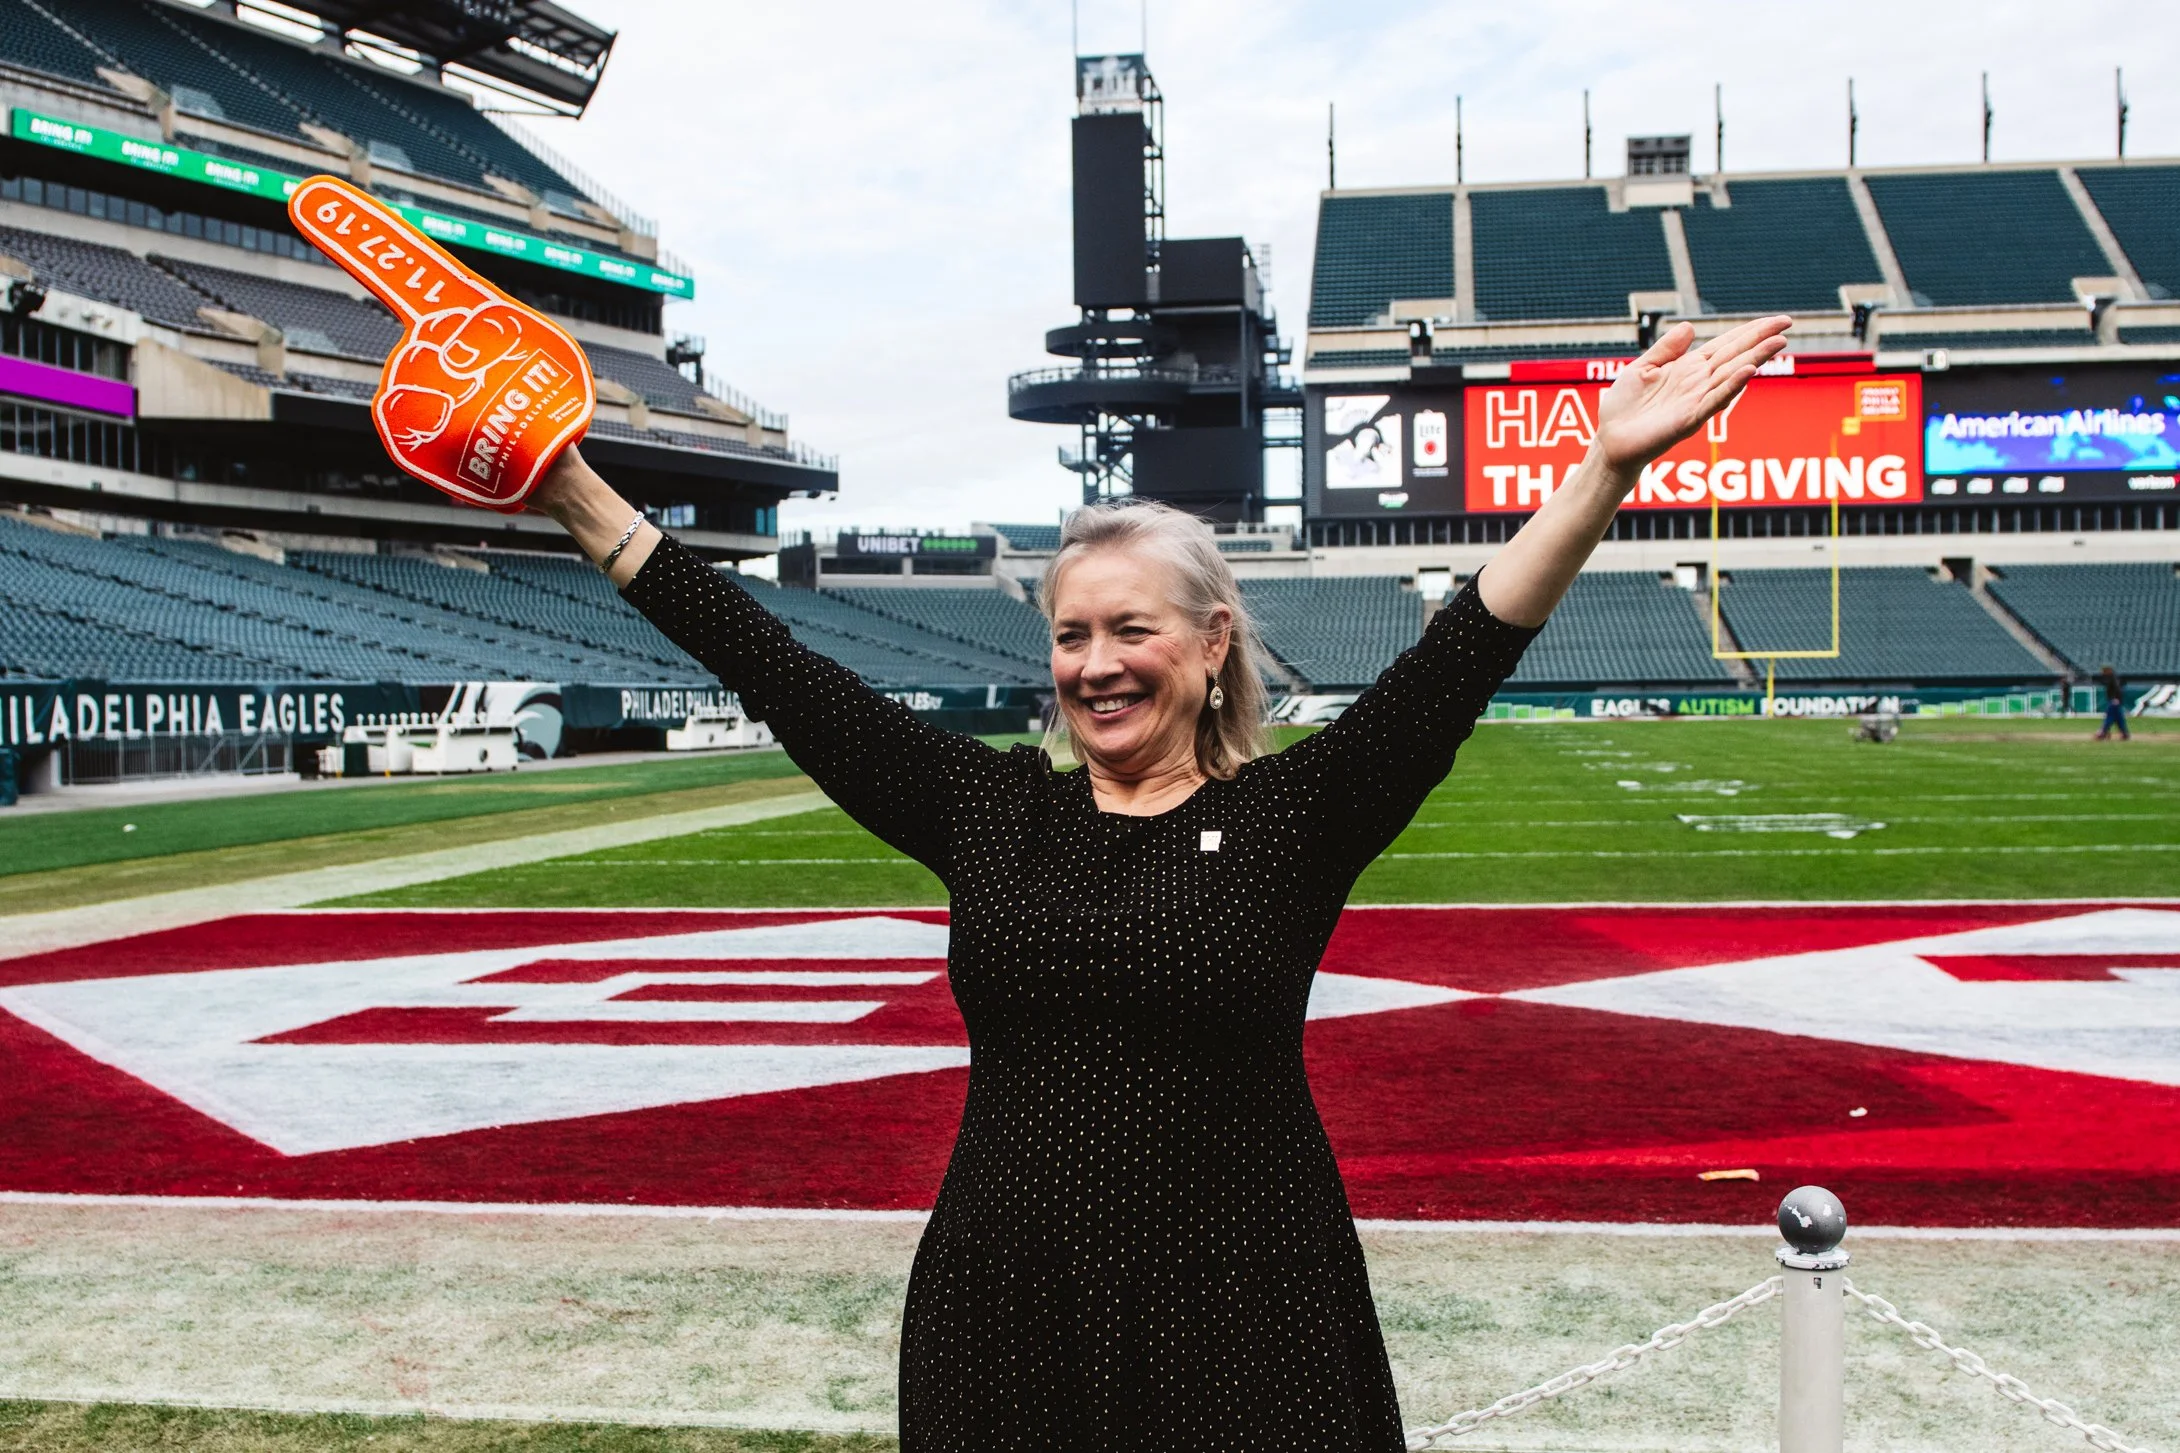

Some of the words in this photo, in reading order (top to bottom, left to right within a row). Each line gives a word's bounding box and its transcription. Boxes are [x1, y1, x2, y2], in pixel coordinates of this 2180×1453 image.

[316, 200, 446, 303] 11.27.19
[468, 389, 531, 480] BRING
[522, 359, 559, 393] IT!
[499, 390, 560, 469] PHILADELPHIA
[1485, 387, 1748, 449] HAY
[1939, 411, 2063, 439] American
[2064, 408, 2166, 435] Airlines
[1483, 455, 1908, 506] THKSGIVING
[857, 536, 921, 554] UNIBET
[239, 692, 346, 736] EAGLES
[1677, 697, 1755, 716] AUTISM
